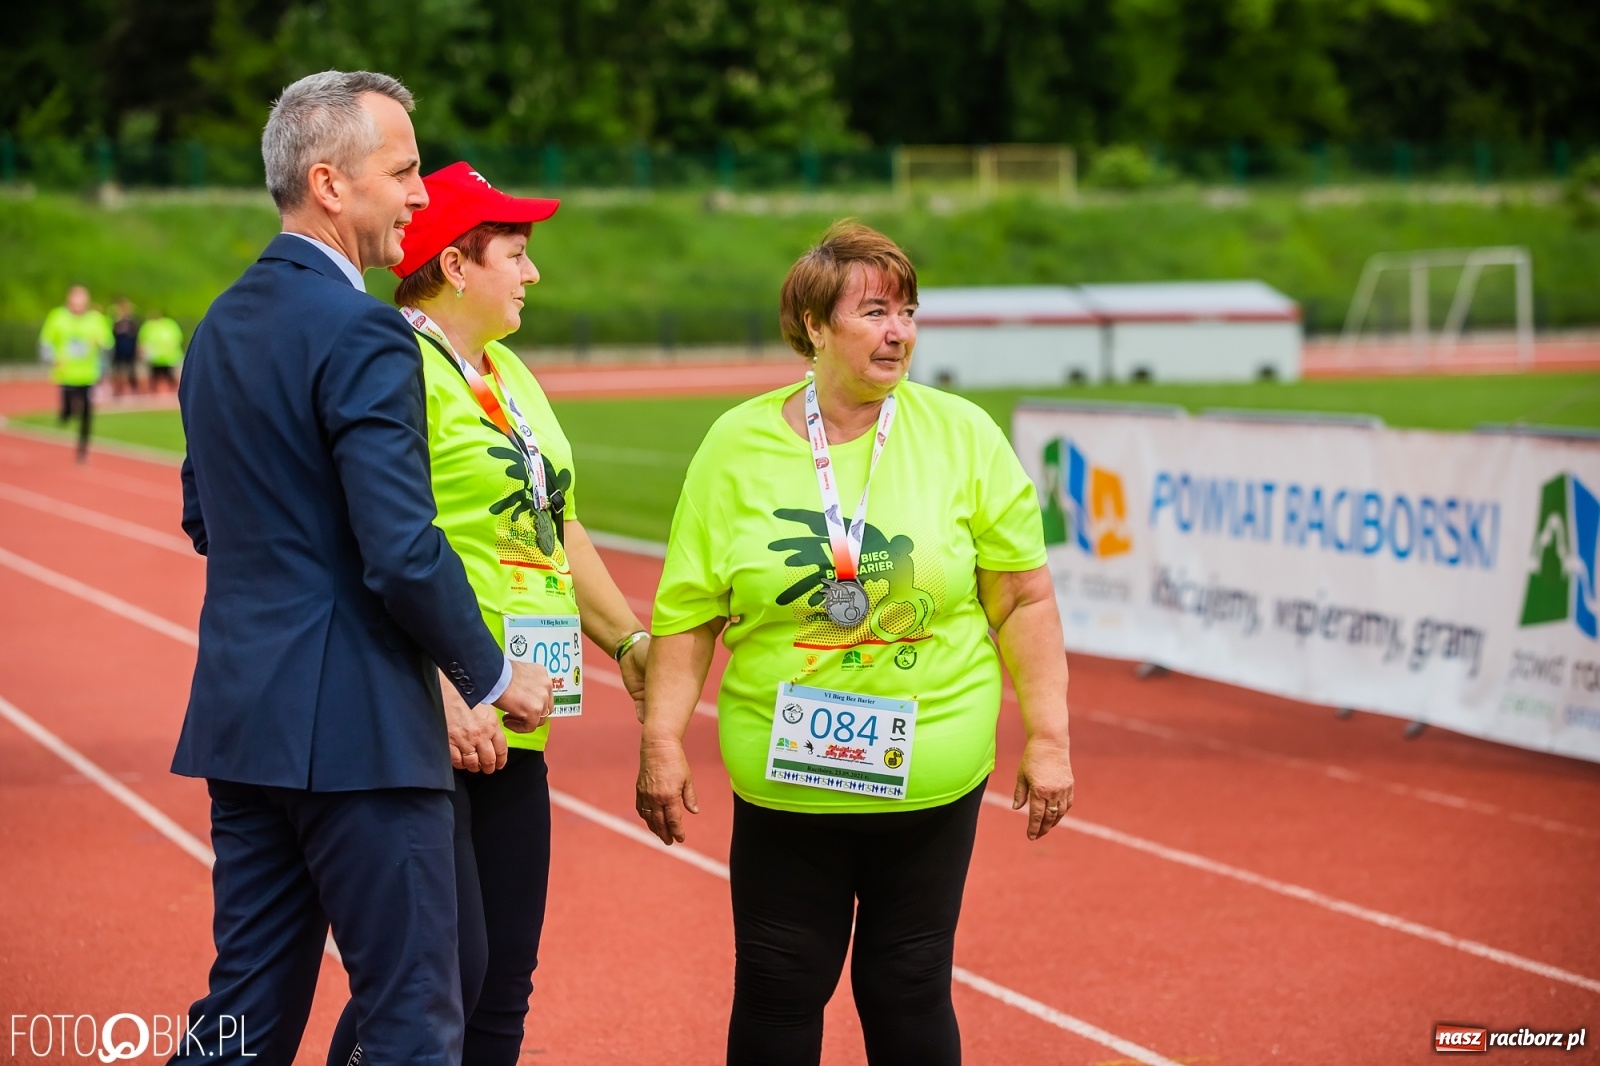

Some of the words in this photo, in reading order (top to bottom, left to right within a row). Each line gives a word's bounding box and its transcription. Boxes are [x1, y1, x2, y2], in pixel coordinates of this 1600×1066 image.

[1149, 471, 1277, 542] POWIAT
[1284, 484, 1503, 571] RACIBORSKI
[861, 550, 889, 563] BIEG
[857, 561, 894, 575] ARIER
[832, 590, 843, 599] VI
[574, 632, 579, 649] R
[533, 641, 571, 673] 085
[833, 693, 845, 702] Bieg
[857, 697, 875, 705] Barier
[810, 707, 878, 746] 084
[892, 717, 906, 736] R
[807, 765, 833, 775] Racibórz,
